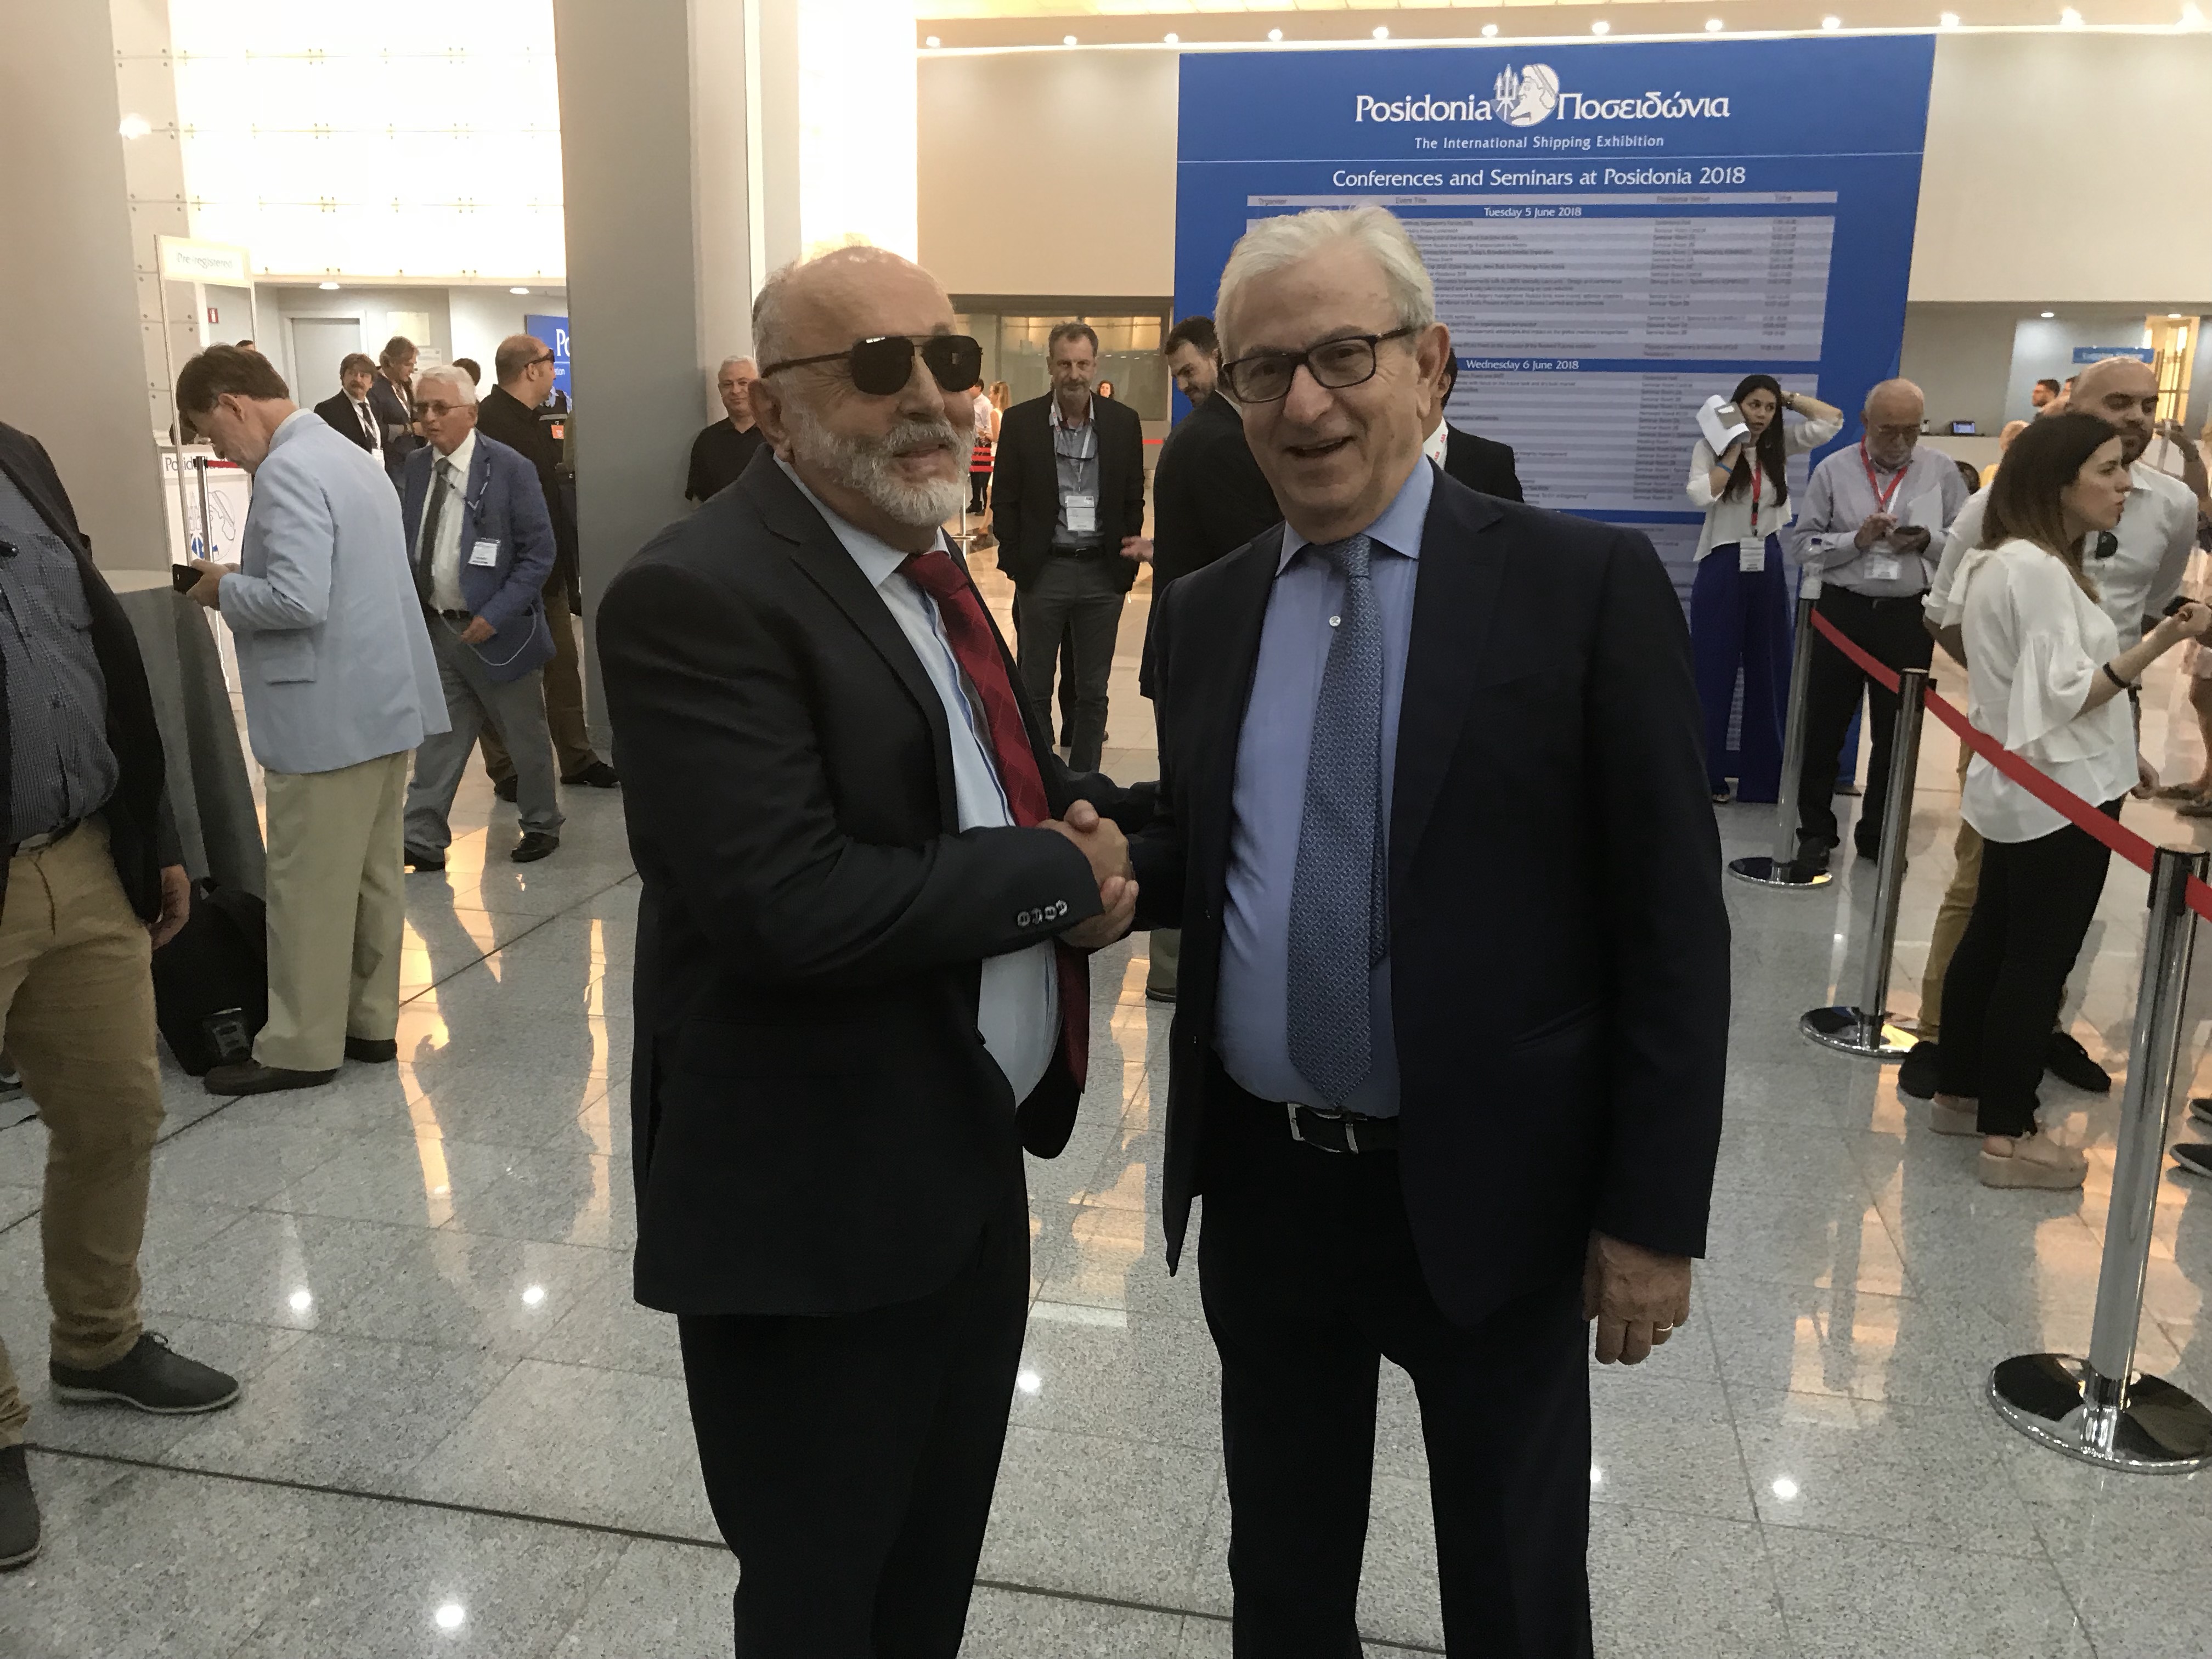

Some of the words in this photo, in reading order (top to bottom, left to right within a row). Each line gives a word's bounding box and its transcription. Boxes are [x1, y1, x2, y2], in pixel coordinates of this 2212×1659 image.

[1355, 94, 1493, 122] Posidonia
[1555, 91, 1730, 120] Ποσειδώνια
[1414, 137, 1438, 149] The
[1443, 136, 1527, 149] International
[1532, 136, 1591, 151] Shipping
[1596, 135, 1664, 148] Exhibition
[1333, 170, 1443, 187] Conferences
[1449, 170, 1483, 186] and
[1490, 169, 1573, 186] Seminars
[1579, 170, 1598, 185] at
[1604, 168, 1692, 185] Posidonia
[1699, 166, 1746, 184] 2018
[1483, 207, 1522, 218] Tuesday
[1524, 208, 1532, 217] 5
[1534, 207, 1555, 218] June
[1558, 207, 1582, 217] 2018
[1466, 359, 1520, 371] Wednesday
[1523, 360, 1530, 370] 6
[1532, 360, 1553, 372] June
[1555, 360, 1579, 370] 2018
